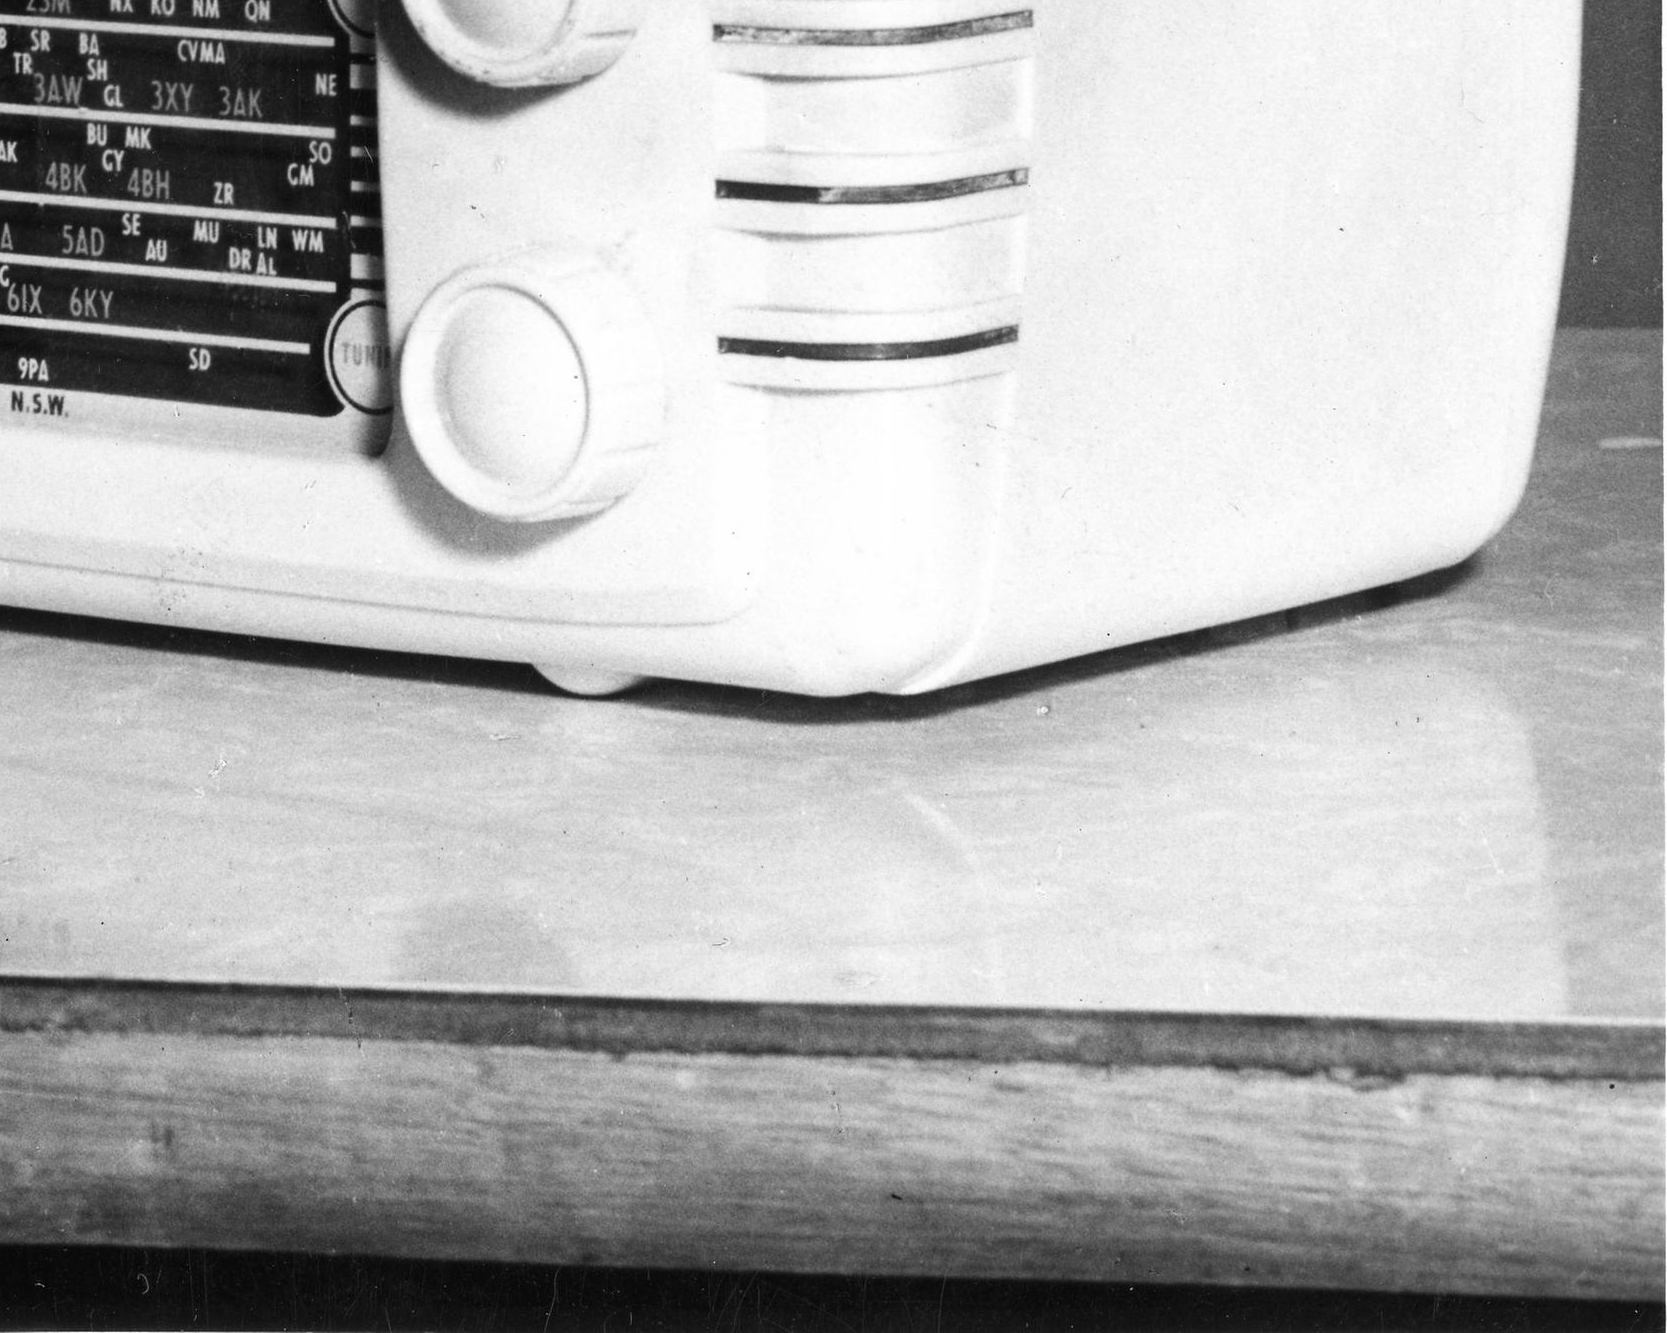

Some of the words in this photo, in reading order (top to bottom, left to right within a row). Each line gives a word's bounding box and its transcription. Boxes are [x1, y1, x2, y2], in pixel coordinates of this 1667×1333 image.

[30, 29, 50, 52] SR
[79, 33, 100, 56] BA
[13, 52, 34, 75] TR
[87, 58, 108, 81] SH
[33, 72, 83, 104] 3AW
[151, 80, 194, 113] 3XY
[315, 73, 337, 97] NE
[219, 86, 263, 118] 3AK
[87, 123, 107, 146] BU
[125, 126, 152, 149] MK
[102, 149, 125, 172] GY
[309, 140, 332, 165] SO
[45, 161, 87, 194] 4BK
[127, 167, 170, 200] 4BH
[287, 163, 315, 187] GM
[213, 181, 235, 206] ZR
[122, 213, 141, 236] SE
[193, 220, 220, 244] MU
[62, 225, 105, 257] 5AD
[257, 226, 278, 249] LN
[292, 229, 324, 253] WM
[229, 247, 251, 271] DR
[256, 252, 277, 276] AL
[7, 283, 43, 314] 6IX
[70, 287, 114, 319] 6KY
[18, 357, 49, 382] 9PA
[188, 348, 212, 372] SD
[10, 390, 69, 418] N.S.W.
